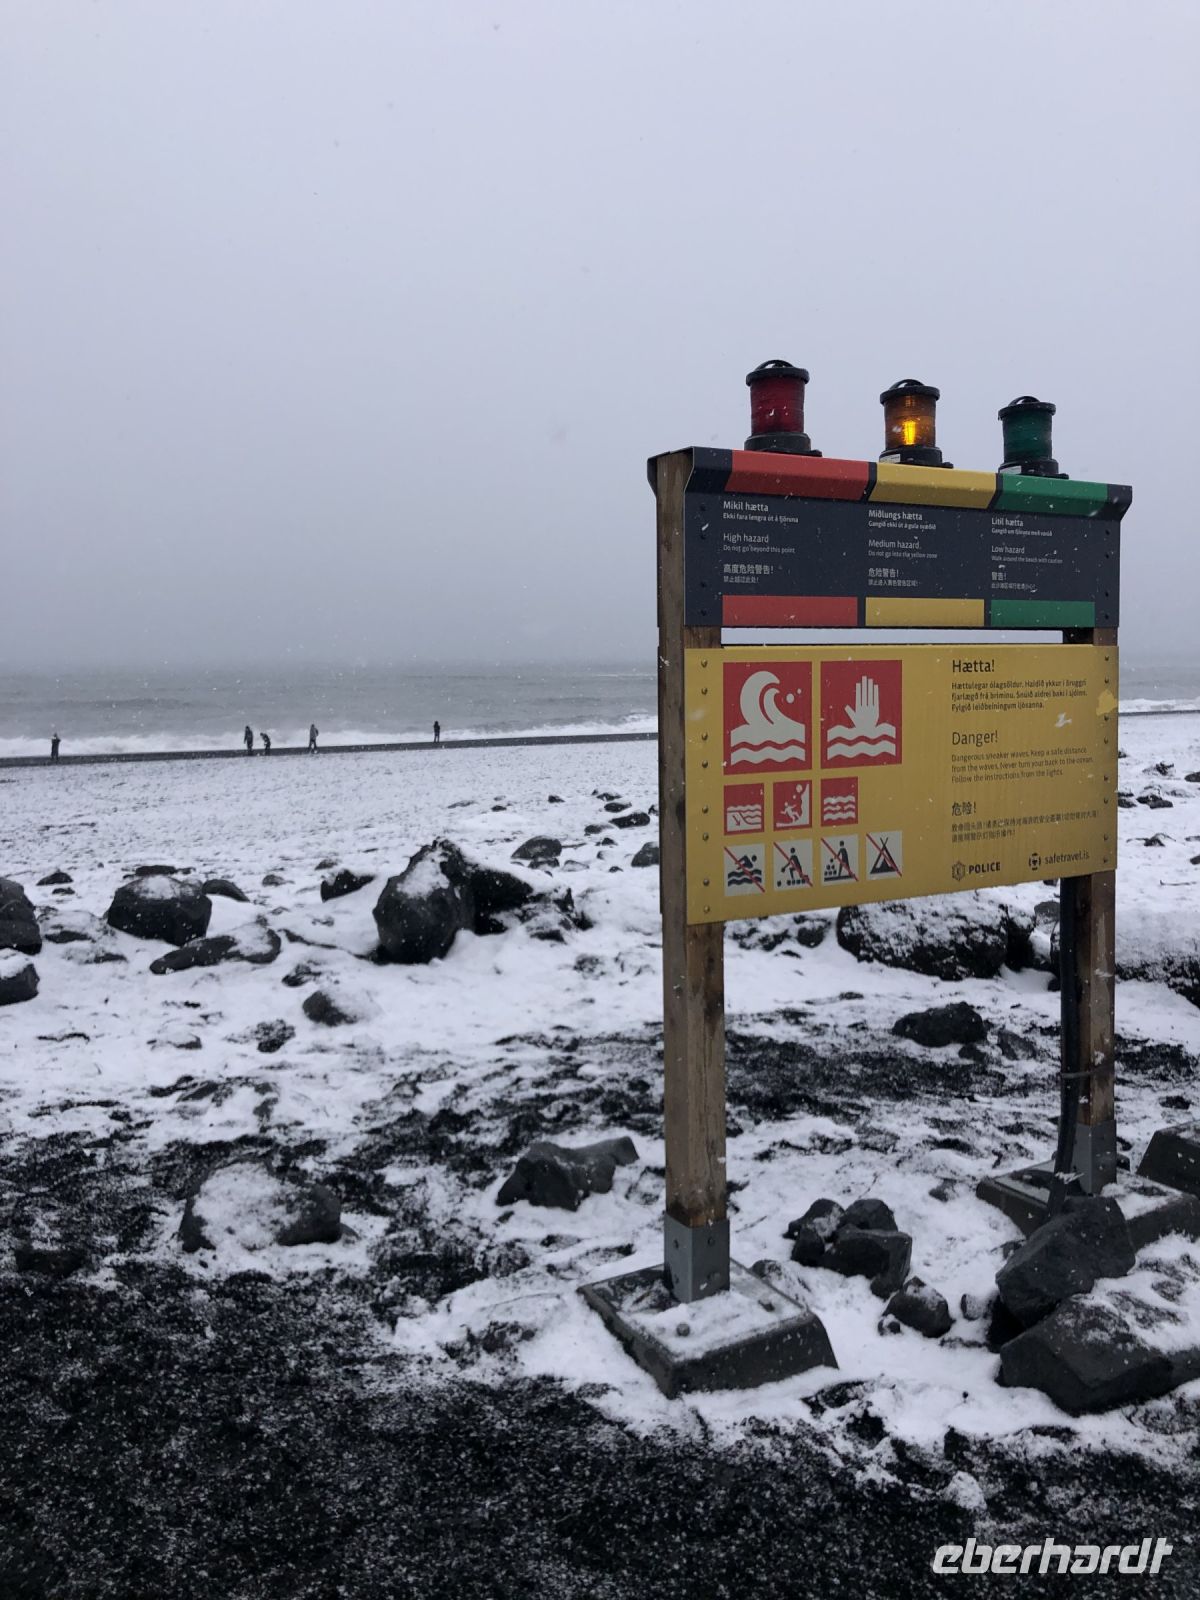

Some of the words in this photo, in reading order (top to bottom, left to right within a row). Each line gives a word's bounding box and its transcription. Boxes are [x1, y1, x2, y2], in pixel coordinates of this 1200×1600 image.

[723, 501, 743, 510] Mikil
[745, 502, 769, 512] hætta
[868, 509, 901, 520] Miðlungs
[902, 512, 923, 520] hætta
[1005, 518, 1023, 526] hætta
[723, 533, 741, 543] High
[744, 533, 769, 543] hazard
[751, 545, 769, 553] beyond
[868, 539, 896, 548] Medium
[897, 540, 920, 549] hazard
[952, 659, 995, 672] Hætta!
[952, 682, 988, 690] Hættulegar
[1046, 680, 1061, 688] ykkur
[952, 692, 978, 701] fjarlægð
[980, 691, 988, 699] frá
[990, 691, 1015, 699] briminu.
[1016, 690, 1033, 698] Snúið
[952, 703, 971, 712] Fylgið
[973, 702, 1016, 711] leiðbeiningum
[1017, 701, 1044, 709] ljósanna.
[952, 730, 998, 747] Danger!
[952, 754, 985, 763] Dangerous
[985, 752, 1008, 760] sneaker
[1031, 749, 1045, 757] Keep
[952, 764, 966, 772] from
[968, 763, 977, 771] the
[1019, 759, 1030, 768] turn
[1032, 760, 1043, 768] your
[1045, 758, 1058, 766] back
[952, 775, 972, 783] Follow
[974, 774, 983, 782] the
[984, 771, 1019, 780] instructions
[1021, 770, 1034, 778] from
[1045, 852, 1089, 864] safetravel.is
[969, 862, 1000, 874] POLICE
